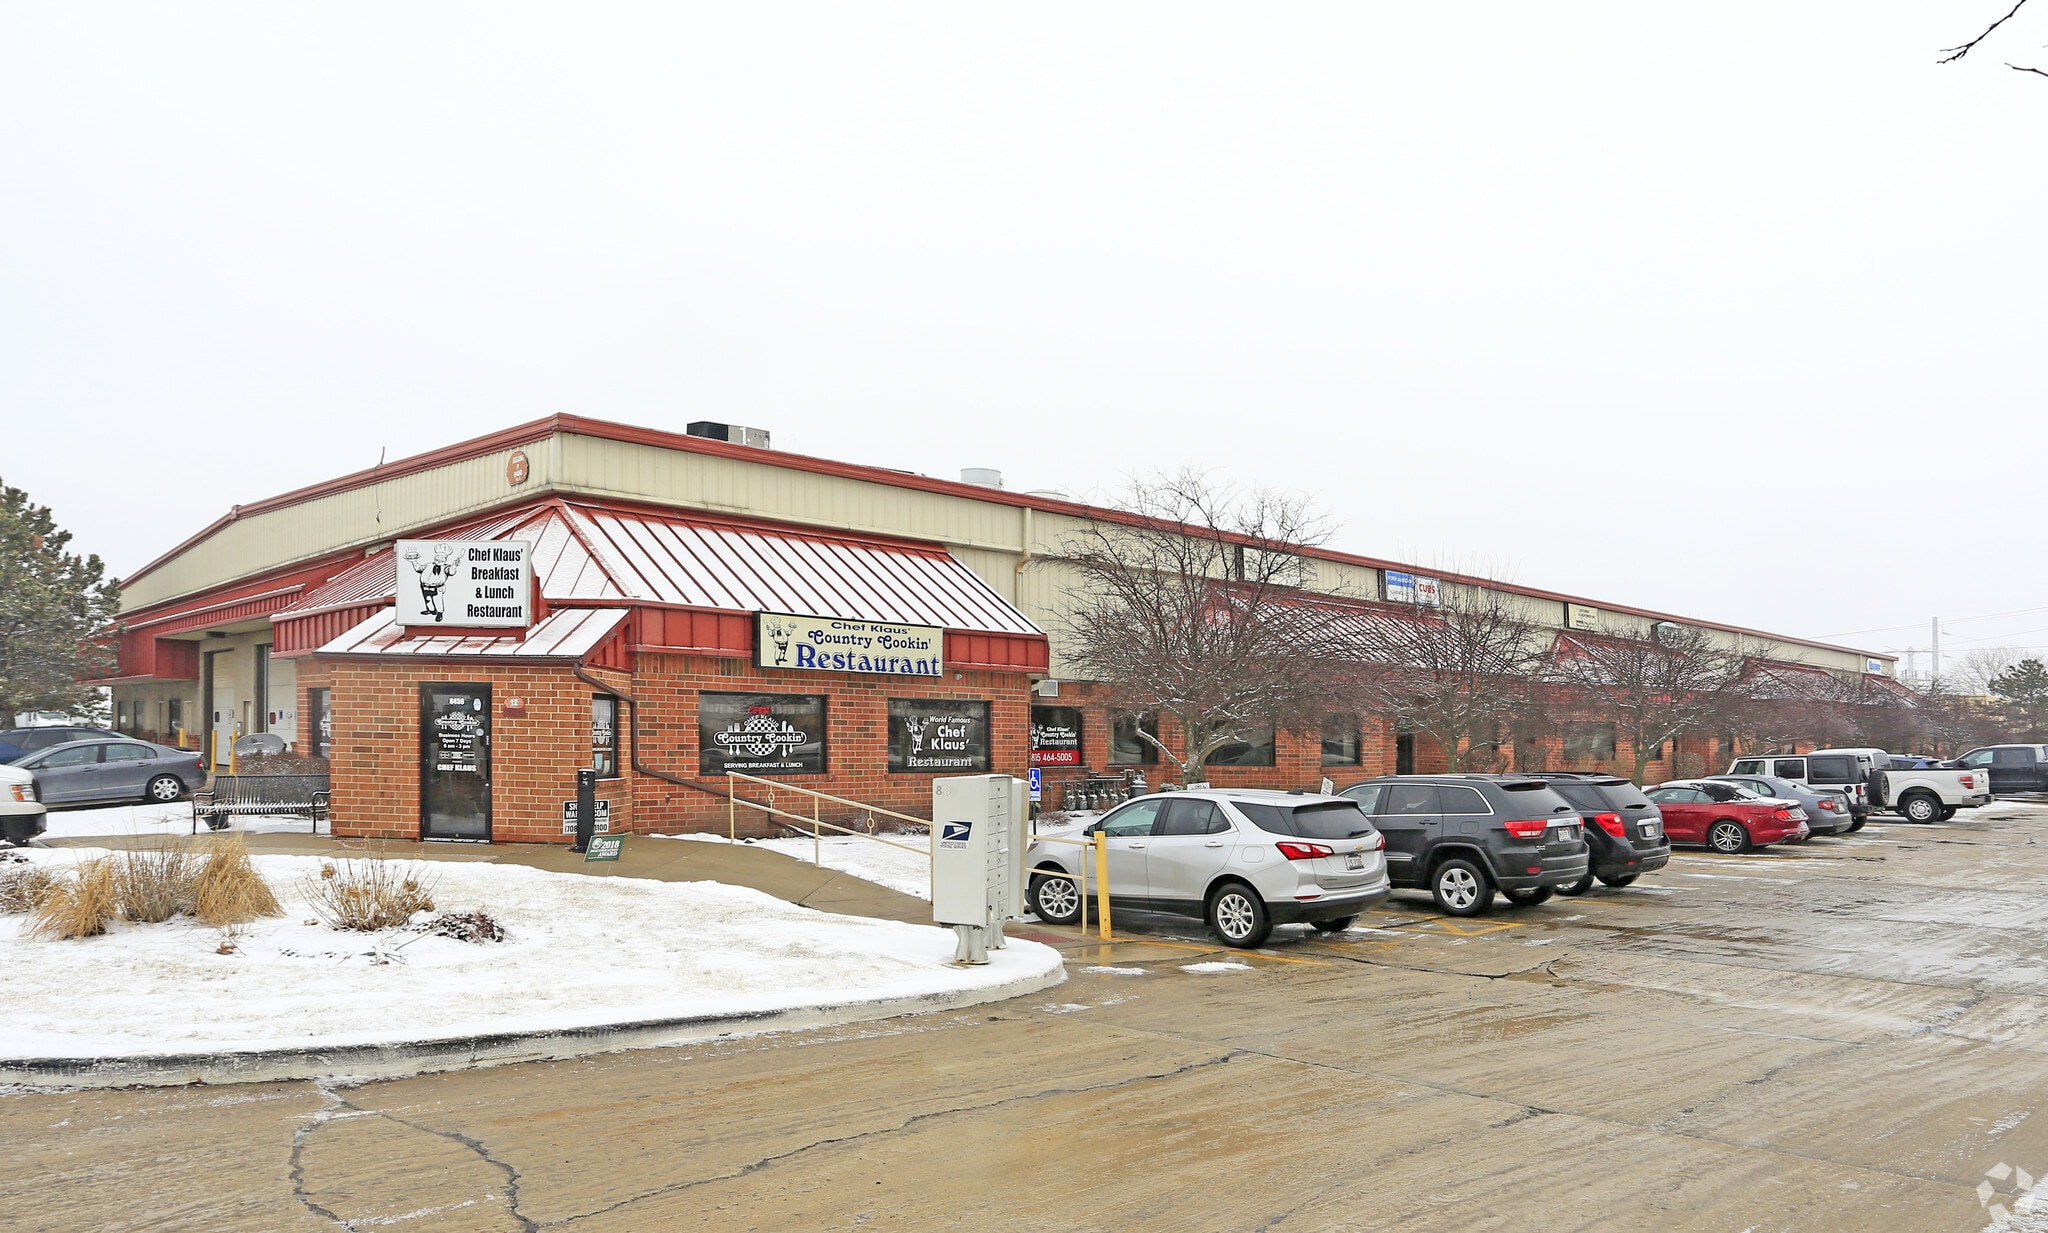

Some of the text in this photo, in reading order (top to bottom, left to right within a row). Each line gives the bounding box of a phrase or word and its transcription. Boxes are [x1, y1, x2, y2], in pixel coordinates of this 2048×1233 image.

[468, 547, 524, 562] Chef Klaus'
[471, 566, 520, 581] Breakfast
[475, 585, 514, 599] & Lunch
[1419, 583, 1436, 594] CUBS
[467, 604, 523, 618] Restaurant
[830, 621, 911, 635] Chef Klaus'
[808, 630, 932, 650] Country Cookin'
[795, 641, 940, 675] Restaurant
[743, 713, 760, 727] CHEF
[929, 715, 971, 724] World Famous
[937, 725, 966, 738] Chef
[717, 732, 805, 744] Country Cookin'
[930, 738, 970, 750] Klaus'
[1040, 738, 1078, 746] Restaurant
[907, 755, 973, 767] Restaurant
[1042, 752, 1073, 762] 464-5005
[437, 763, 477, 772] CHEF KLAUS
[935, 785, 943, 796] 8
[601, 840, 621, 849] 2018
